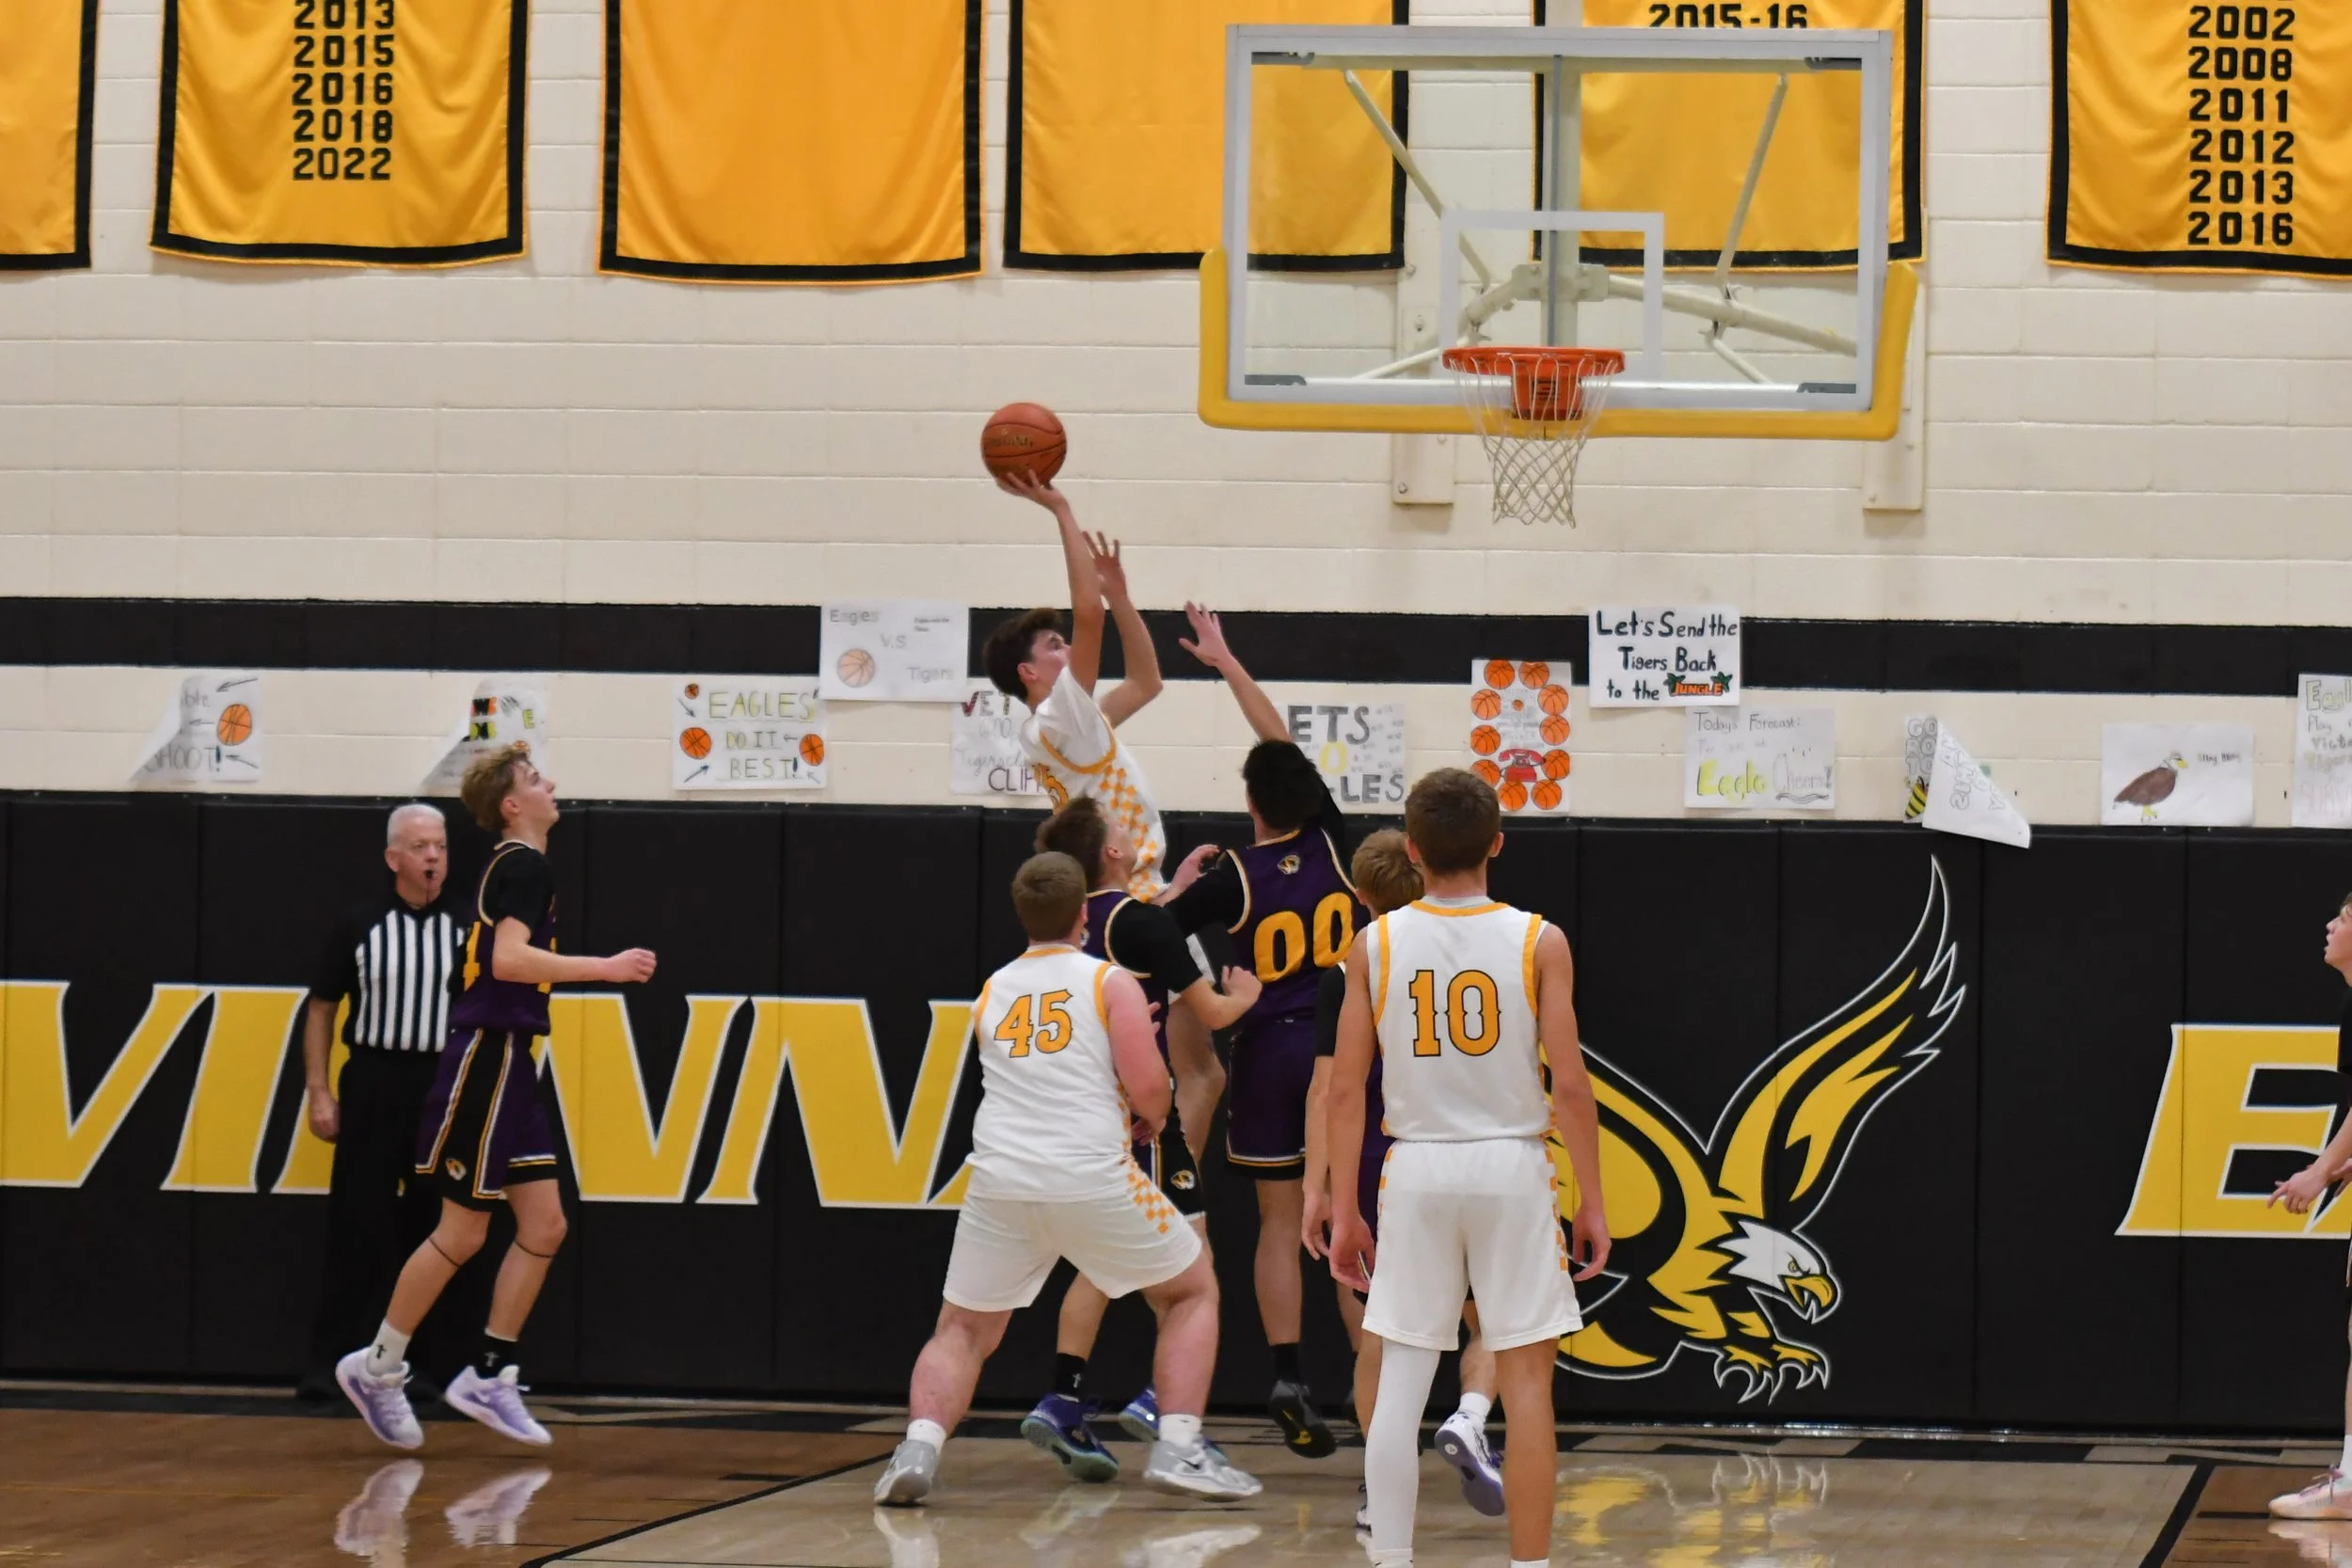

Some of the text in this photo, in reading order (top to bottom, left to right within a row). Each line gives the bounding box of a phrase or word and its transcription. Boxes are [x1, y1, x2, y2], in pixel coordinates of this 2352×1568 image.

[294, 0, 395, 29] 2013
[1648, 3, 1808, 28] 2015-16
[2188, 6, 2296, 41] 2002
[294, 34, 395, 68] 2015
[2188, 46, 2293, 82] 2008
[292, 71, 393, 105] 2016
[2189, 87, 2288, 123] 2011
[293, 108, 393, 143] 2018
[293, 147, 391, 181] 2022
[2189, 129, 2295, 165] 2012
[2189, 169, 2294, 205] 2013
[2187, 212, 2294, 246] 2016
[1595, 610, 1738, 638] Let's Send the
[1617, 645, 1717, 673] Tigers Back
[708, 691, 816, 721] EAGLES
[1606, 678, 1724, 701] to the JUNGLE
[1287, 705, 1370, 745] ETS
[730, 756, 798, 780] BEST!
[1254, 893, 1354, 982] 00
[993, 988, 1073, 1058] 45
[1408, 969, 1502, 1058] 10
